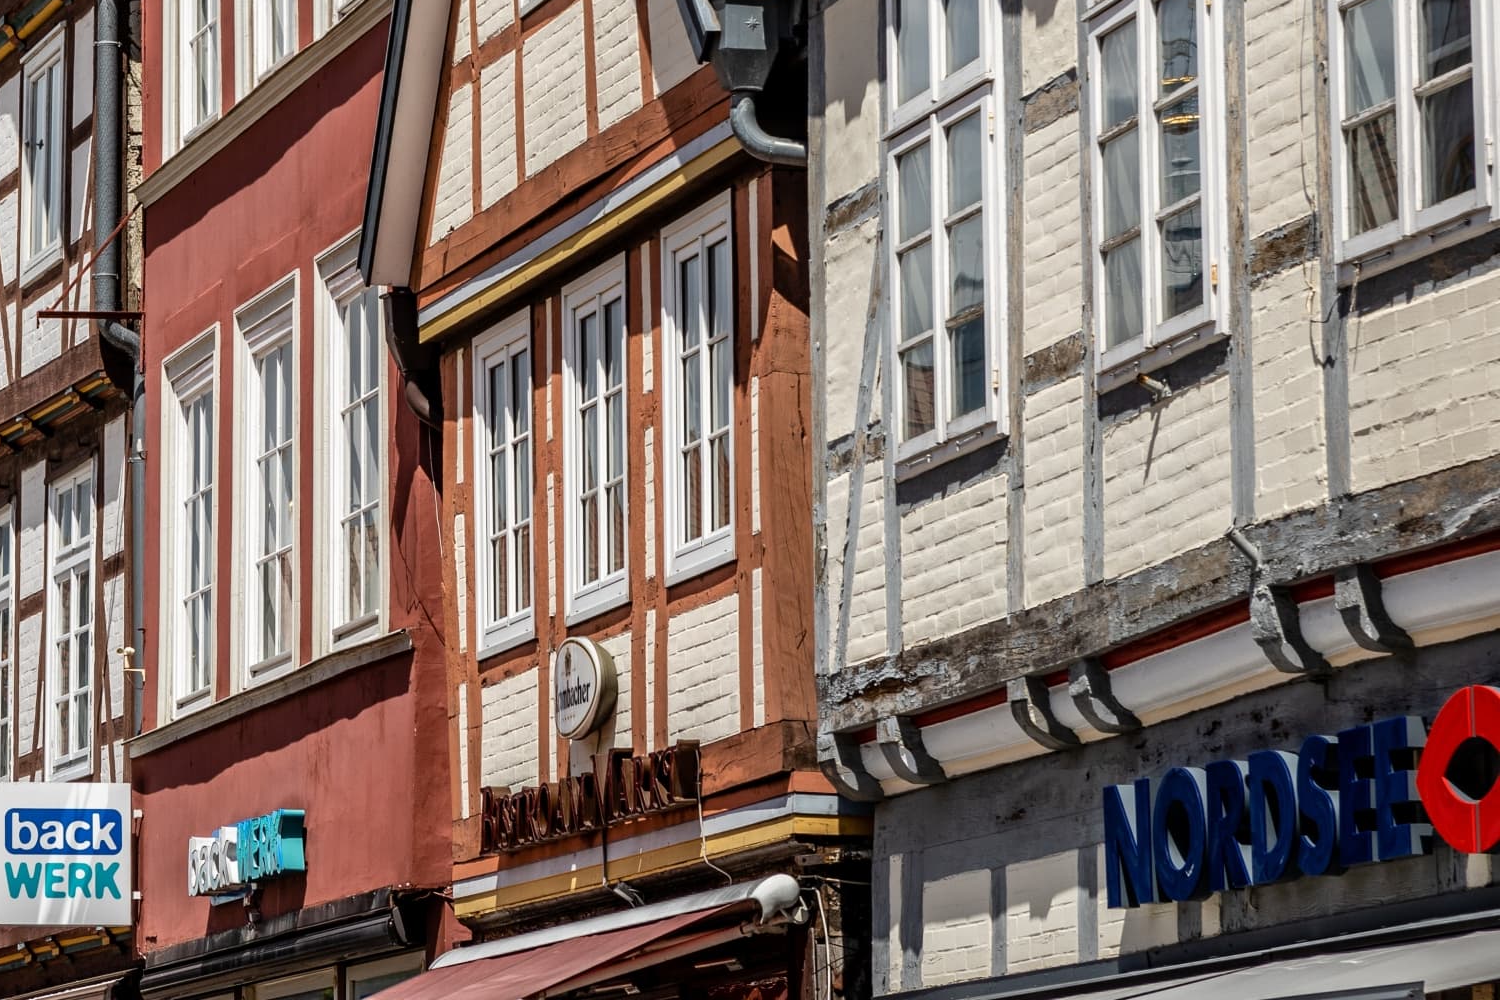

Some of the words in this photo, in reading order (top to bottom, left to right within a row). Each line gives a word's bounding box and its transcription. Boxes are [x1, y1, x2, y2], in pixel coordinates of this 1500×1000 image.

[10, 812, 117, 851] back
[1103, 715, 1430, 909] NORDSEE
[5, 862, 122, 899] WERK
